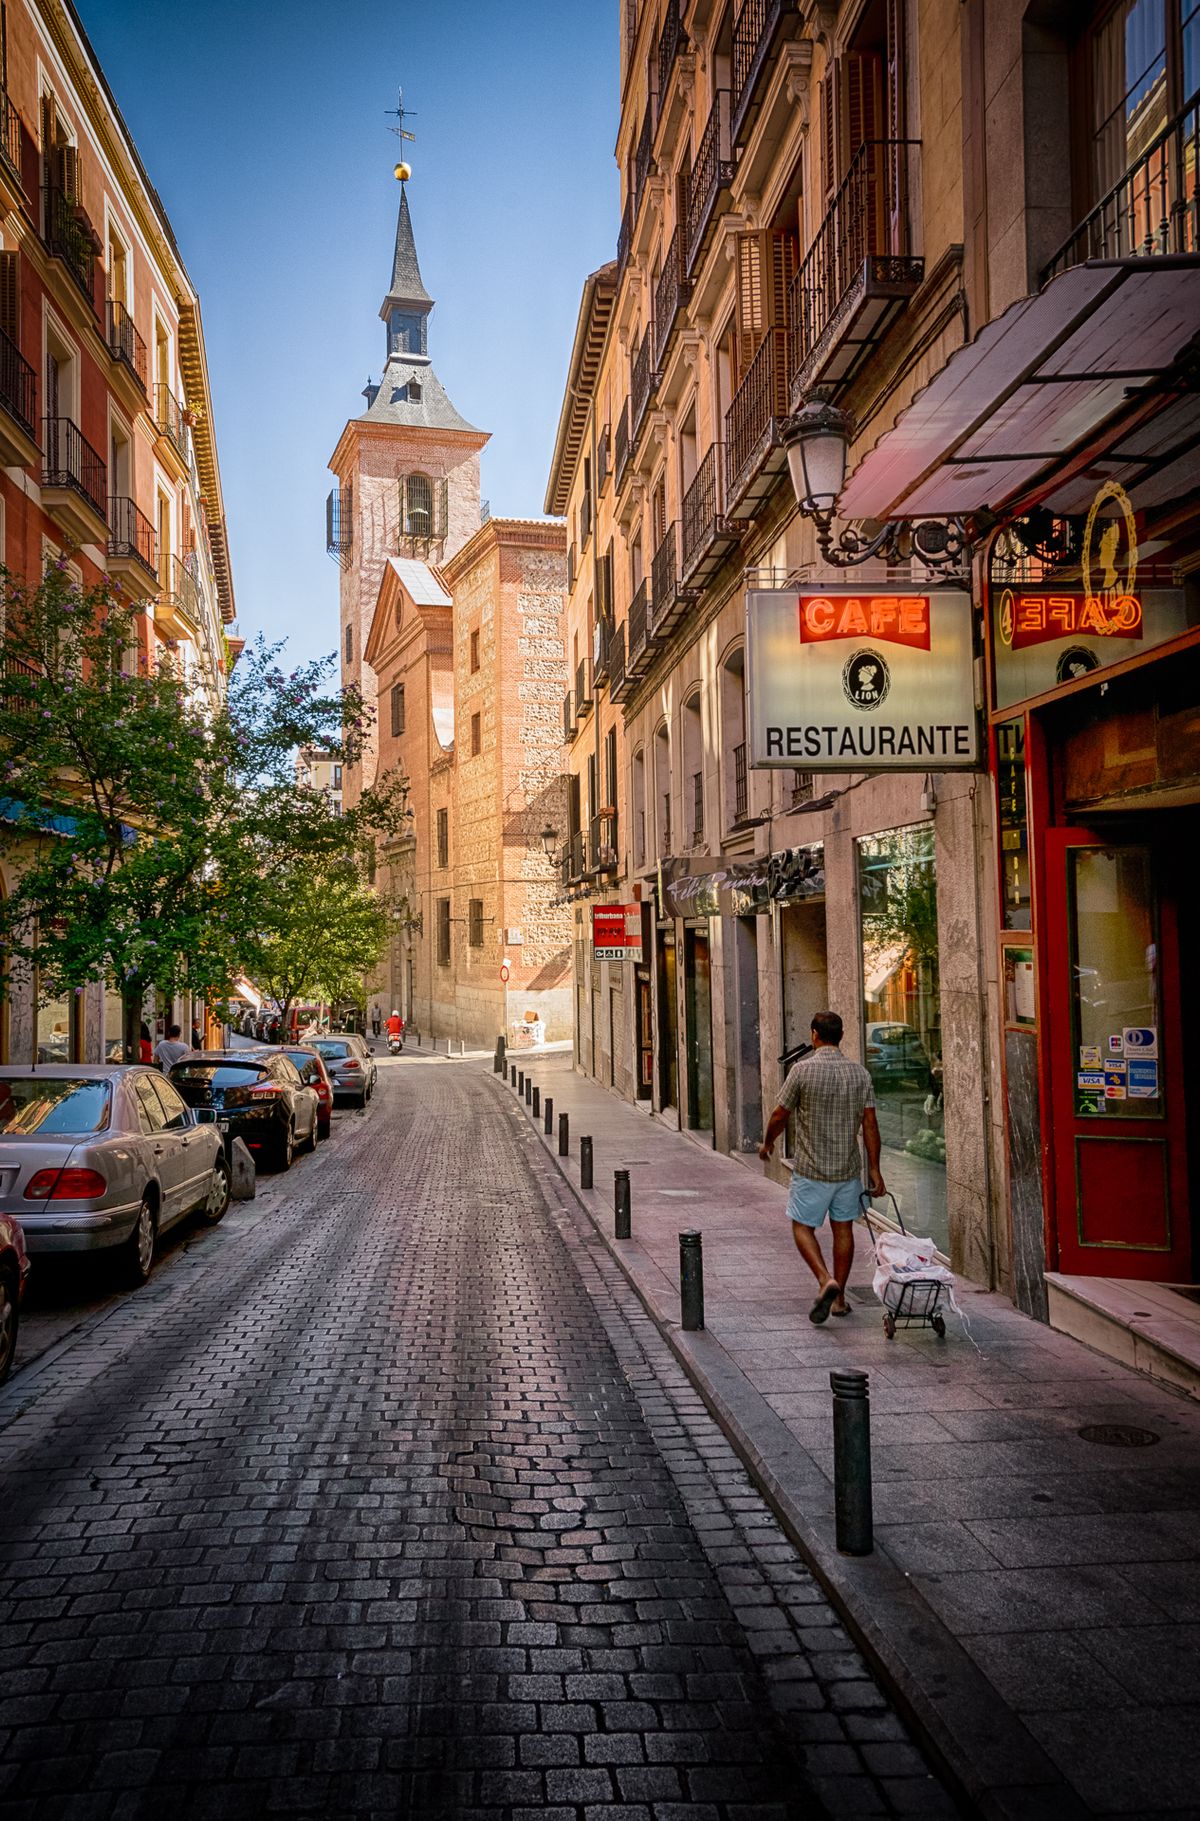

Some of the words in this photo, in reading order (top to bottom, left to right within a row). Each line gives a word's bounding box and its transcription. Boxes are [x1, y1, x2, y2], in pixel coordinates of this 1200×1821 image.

[805, 598, 927, 634] CAFE
[1002, 599, 1012, 634] 4
[855, 690, 879, 700] LION
[766, 725, 970, 757] RESTAURANTE
